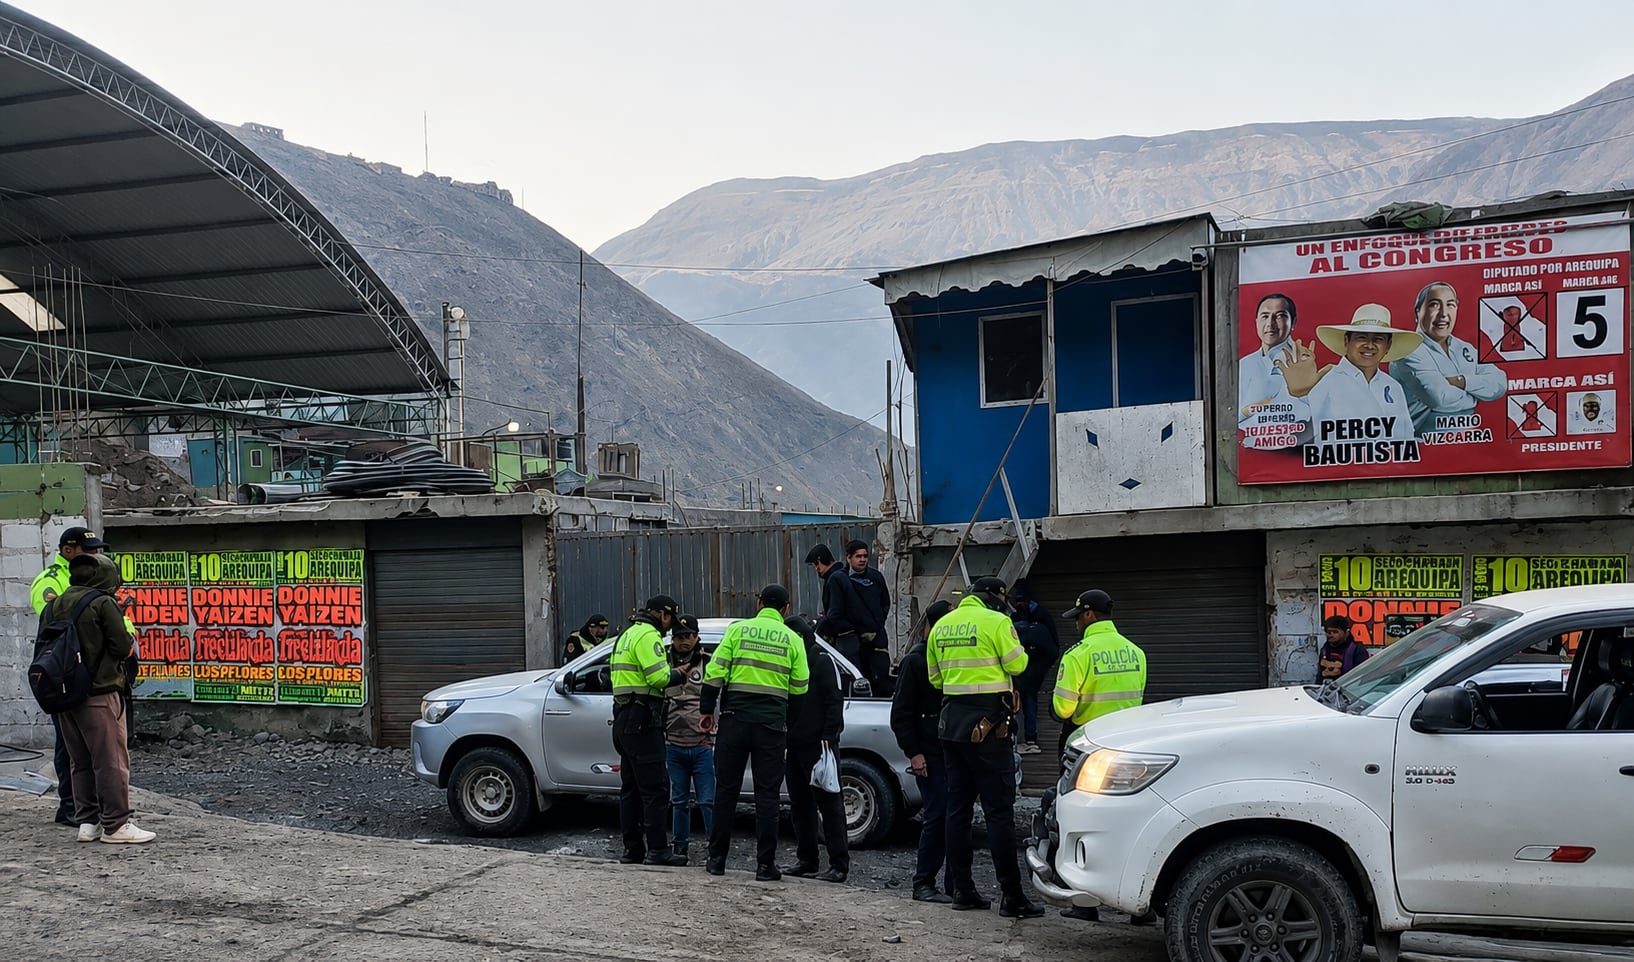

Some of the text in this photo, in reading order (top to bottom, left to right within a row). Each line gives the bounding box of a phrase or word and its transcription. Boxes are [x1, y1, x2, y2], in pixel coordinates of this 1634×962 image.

[1296, 243, 1325, 256] UN
[1331, 232, 1428, 253] ENFOQUE
[1309, 237, 1553, 274] AL CONGRESO
[1483, 258, 1620, 279] DIPUTADO POR AREQUIPA
[1484, 279, 1543, 295] MARCA ASÍ
[1572, 294, 1608, 350] 5
[1508, 371, 1615, 391] MARCA ASÍ
[1320, 416, 1397, 441] PERCY
[1436, 414, 1481, 429] MARIO
[1254, 436, 1296, 448] AMIGO
[1423, 429, 1492, 446] VIZCARRA
[1521, 440, 1603, 453] PRESIDENTE
[1304, 440, 1420, 467] BAUTISTA
[114, 553, 135, 582] 0
[135, 563, 186, 580] AREQUIPA
[199, 553, 221, 582] 10
[222, 563, 273, 580] AREQUIPA
[284, 551, 309, 579] 10
[310, 560, 362, 578] AREQUIPA
[1334, 556, 1372, 591] 10
[1488, 557, 1528, 592] 10
[1375, 568, 1460, 590] AREQUIPA
[192, 588, 274, 606] DONNIE
[278, 586, 362, 606] DONNIE
[124, 606, 188, 623] AIDEN
[193, 606, 273, 624] YAIZEN
[279, 606, 362, 624] YAIZEN
